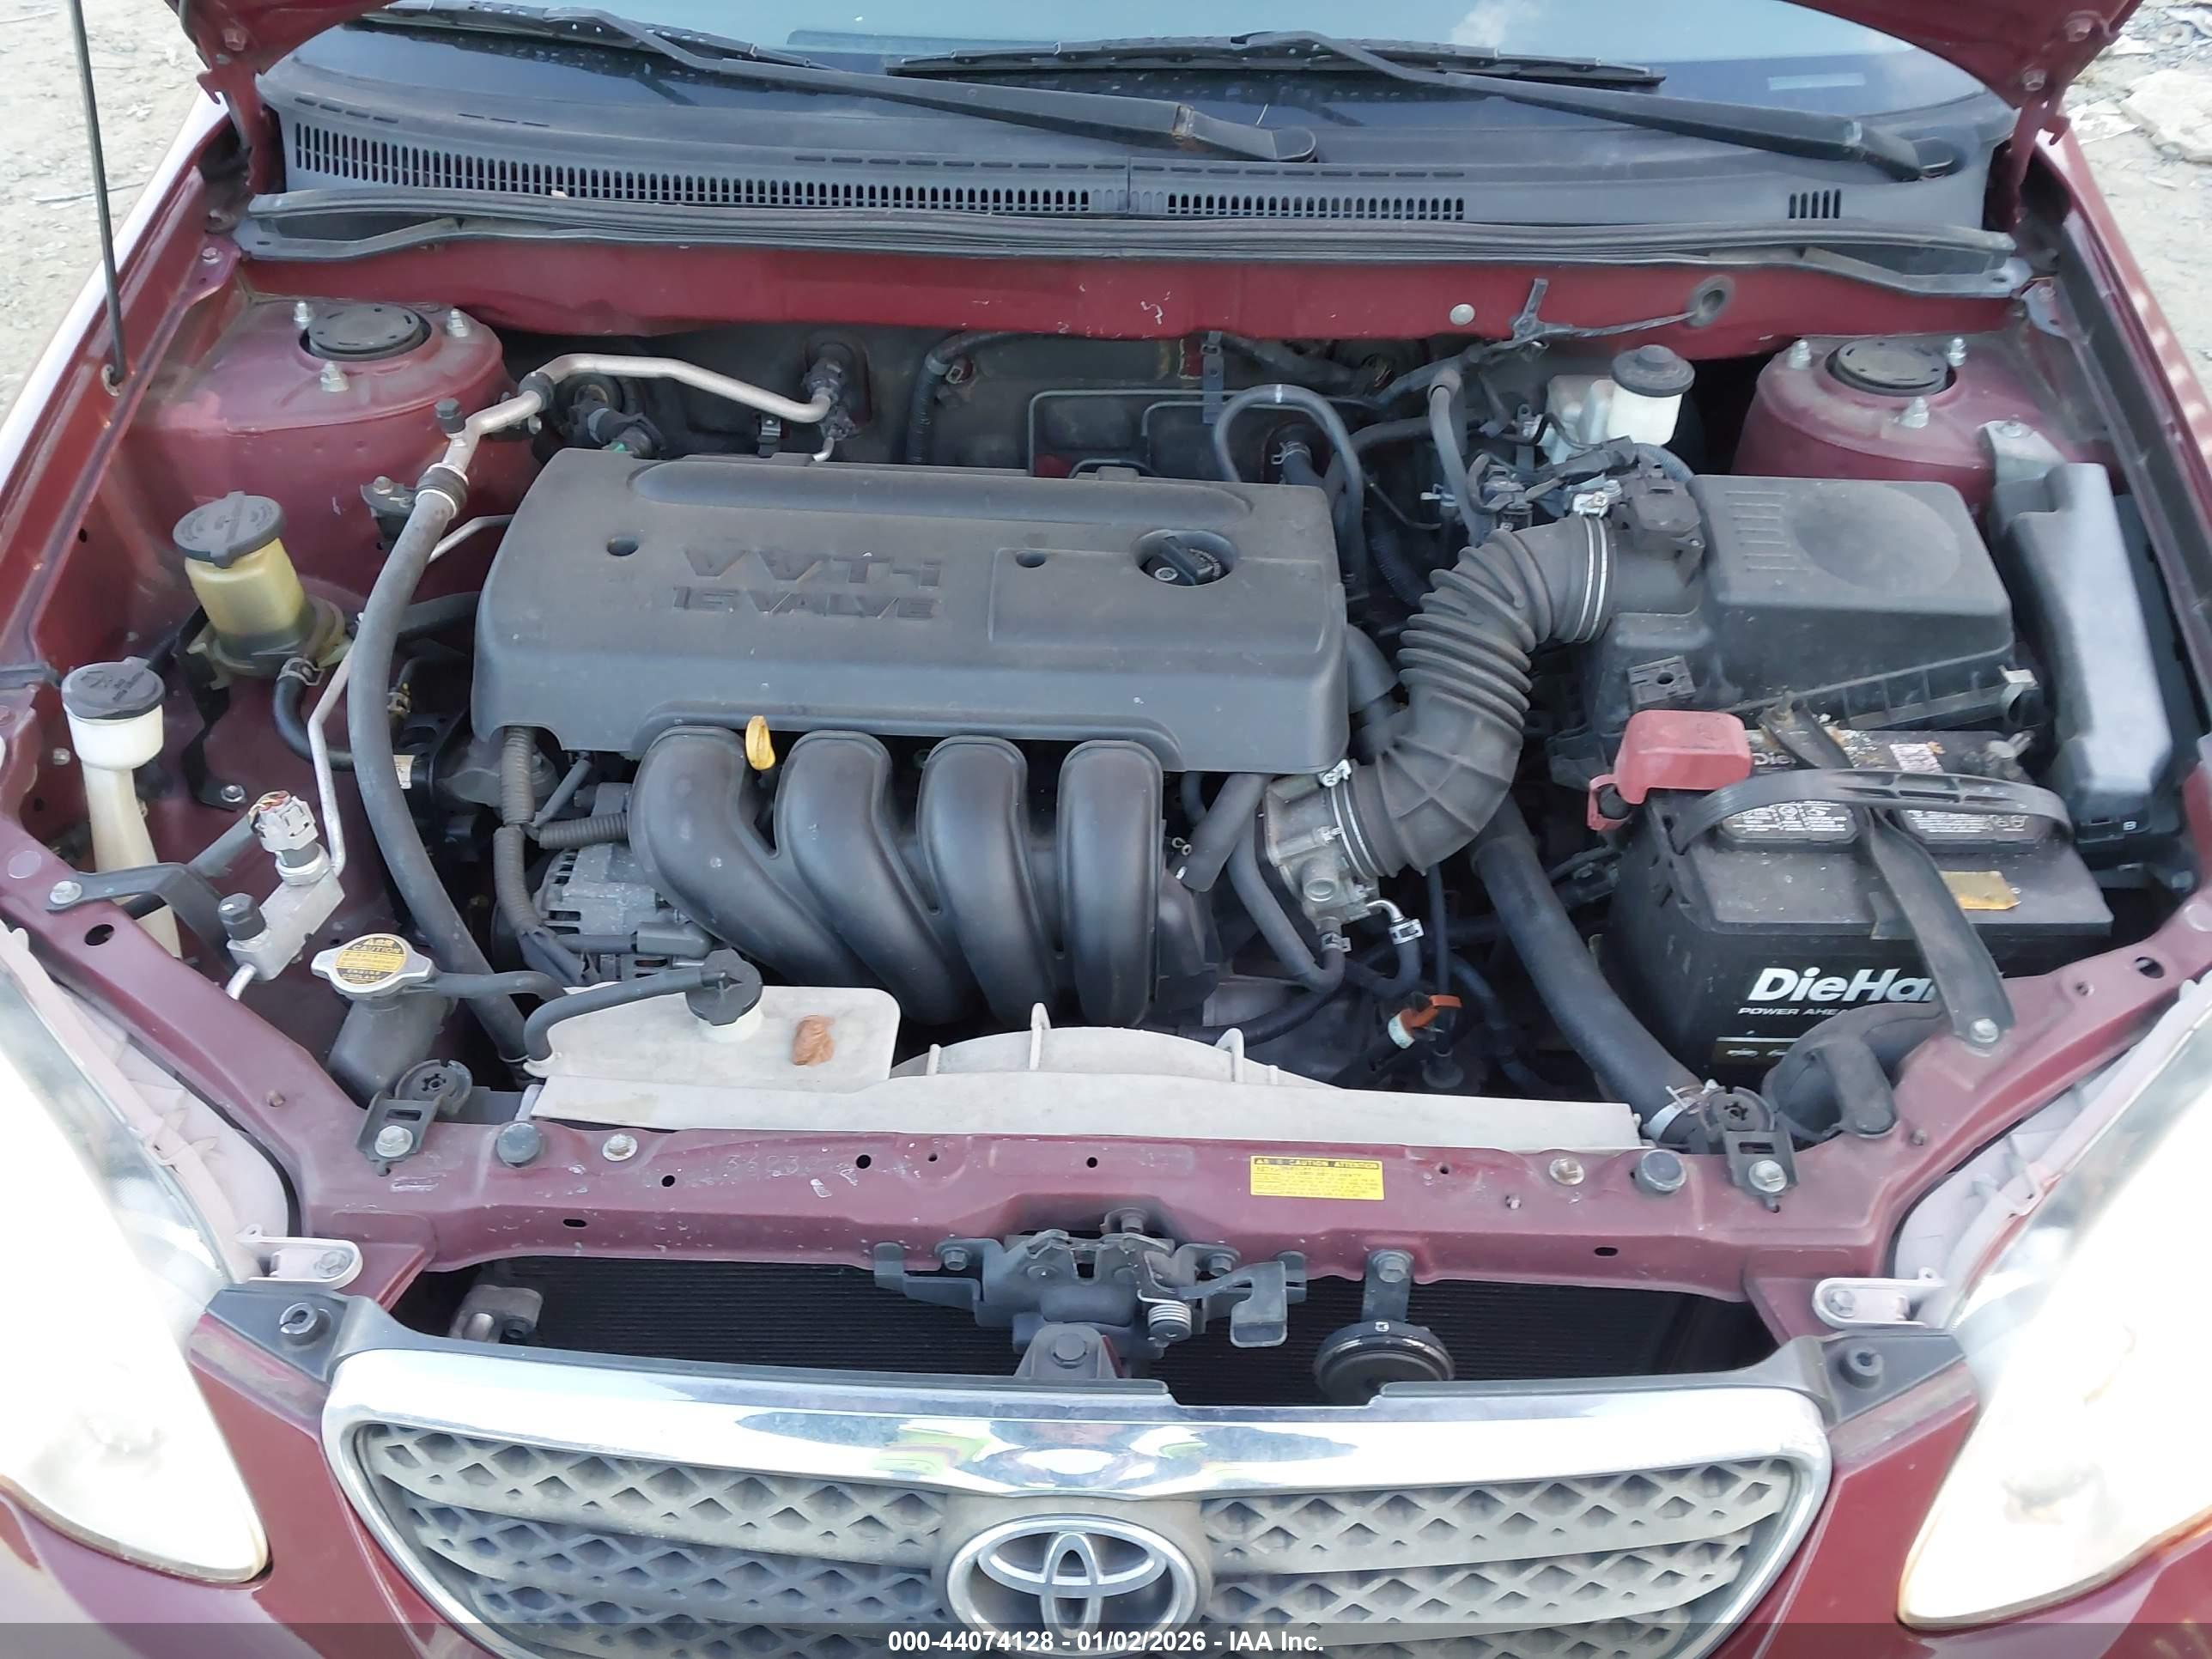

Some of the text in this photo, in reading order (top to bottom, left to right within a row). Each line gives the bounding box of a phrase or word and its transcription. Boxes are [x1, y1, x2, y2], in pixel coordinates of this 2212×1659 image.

[746, 589, 936, 619] VALVE
[1737, 1007, 1848, 1016] POWER AHE
